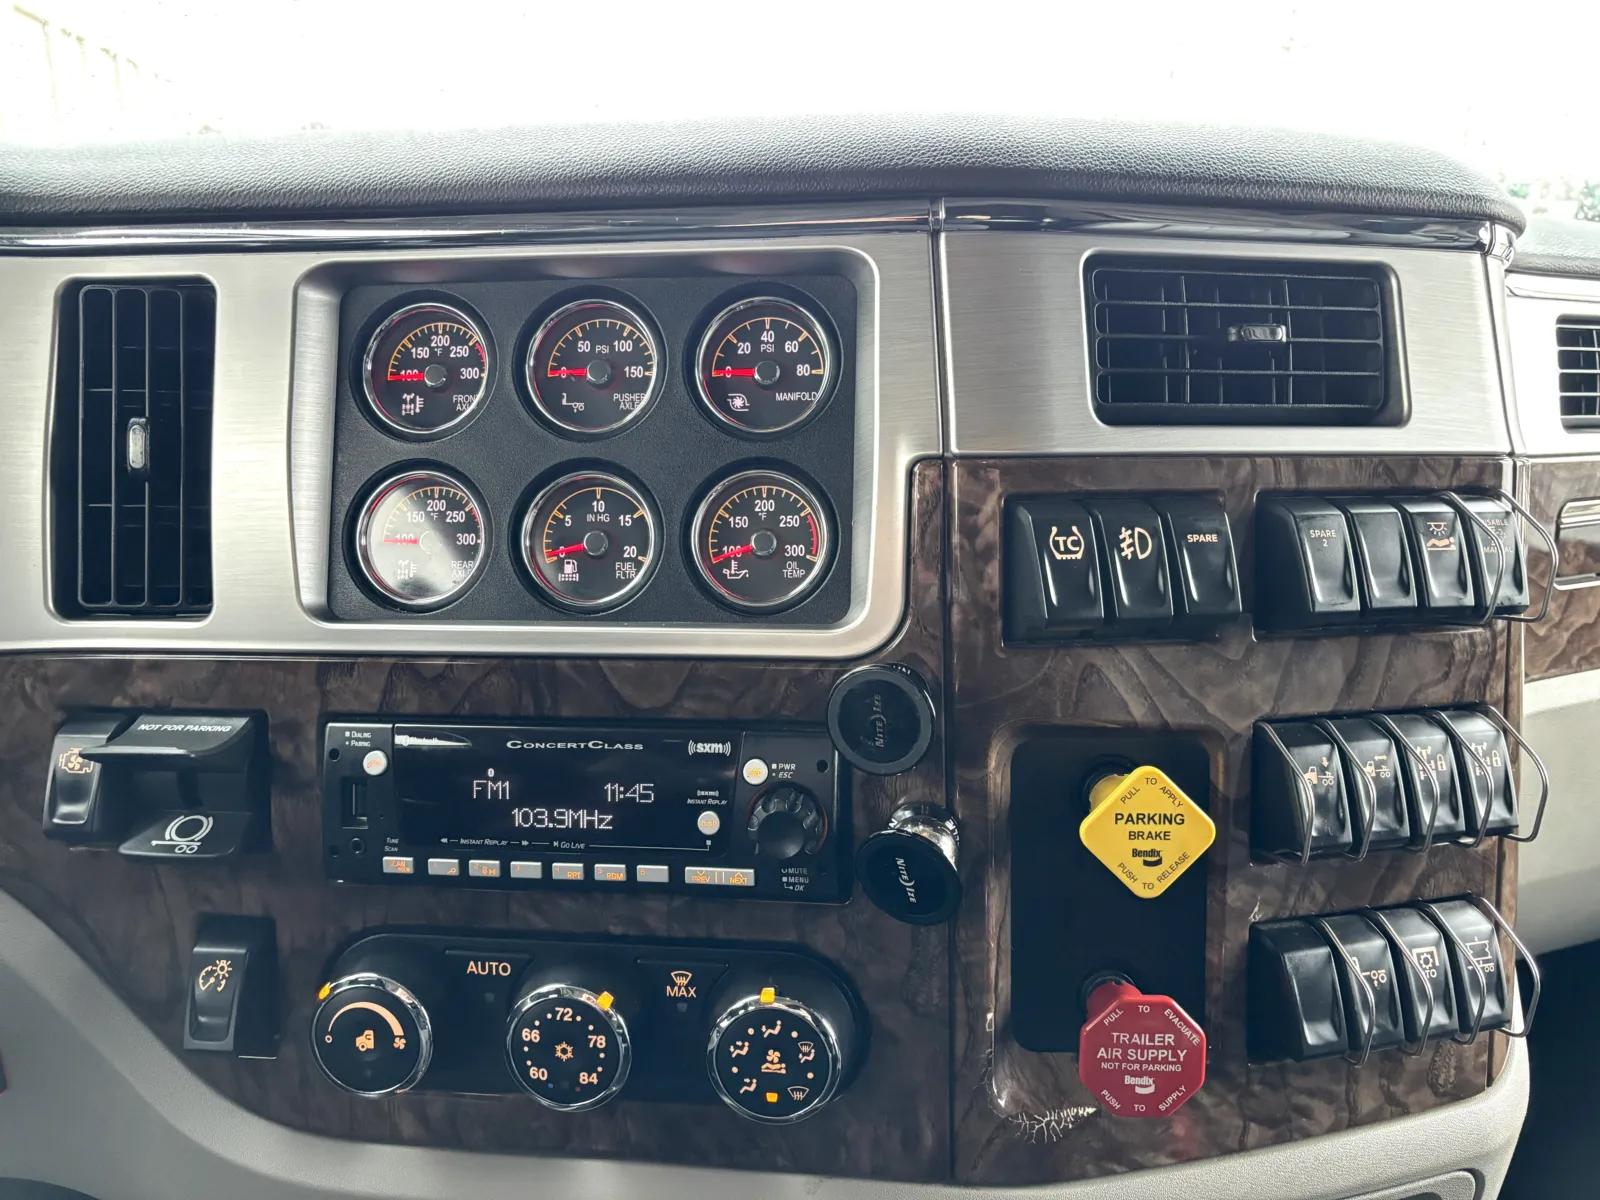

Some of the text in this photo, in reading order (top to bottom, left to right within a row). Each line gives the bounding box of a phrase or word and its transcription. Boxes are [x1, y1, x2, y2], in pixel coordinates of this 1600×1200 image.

[430, 335, 450, 346] 200
[760, 330, 774, 342] 40
[450, 346, 469, 358] 250
[578, 340, 590, 352] 50
[596, 345, 610, 354] PSI
[613, 340, 632, 352] 100
[738, 342, 751, 354] 20
[760, 344, 774, 352] PSI
[785, 341, 798, 352] 60
[411, 347, 430, 358] 150
[460, 368, 480, 379] 300
[624, 366, 644, 378] 150
[796, 364, 810, 376] 80
[776, 392, 818, 401] MANIFOLD
[426, 500, 446, 512] 200
[592, 500, 605, 512] 10
[754, 500, 774, 512] 200
[406, 511, 425, 522] 150
[446, 511, 466, 522] 250
[564, 515, 572, 526] 5
[586, 514, 610, 522] IN HG
[619, 515, 632, 526] 15
[728, 516, 748, 528] 150
[780, 516, 800, 527] 250
[456, 534, 476, 545] 300
[1186, 534, 1218, 543] SPARE
[1310, 530, 1336, 538] SPARE
[1054, 536, 1080, 552] TC
[1322, 539, 1328, 547] 2
[624, 546, 636, 558] 20
[784, 545, 804, 556] 300
[452, 560, 474, 568] REAR
[616, 562, 636, 570] FUEL
[786, 562, 799, 570] OIL
[616, 570, 636, 579] FLTR
[782, 570, 806, 578] TEMP
[473, 780, 510, 800] FM1
[604, 782, 654, 803] 11:45
[1120, 786, 1141, 804] PULL
[1160, 786, 1184, 808] APPLY
[512, 808, 613, 830] 103.9MHz
[1114, 813, 1185, 825] PARKING
[1128, 830, 1171, 840] BRAKE
[484, 838, 508, 846] REPLAY
[1132, 848, 1161, 858] Bendix
[896, 858, 909, 880] NITE
[1118, 851, 1190, 890] PUSH TO RELEASE
[466, 960, 512, 976] AUTO
[666, 986, 697, 998] MAX
[554, 1007, 573, 1022] 72
[1103, 1008, 1124, 1026] PULL
[1164, 1008, 1200, 1046] EVACUATE
[522, 1028, 540, 1043] 66
[1112, 1032, 1175, 1046] TRAILER
[588, 1036, 606, 1048] 78
[1096, 1048, 1188, 1062] AIR SUPPLY
[530, 1066, 548, 1080] 60
[1102, 1062, 1118, 1070] NOT
[1142, 1064, 1182, 1072] PARKING
[579, 1072, 598, 1085] 84
[1124, 1075, 1154, 1086] Bendix
[1101, 1085, 1187, 1112] PUSH TO SUPPLY
